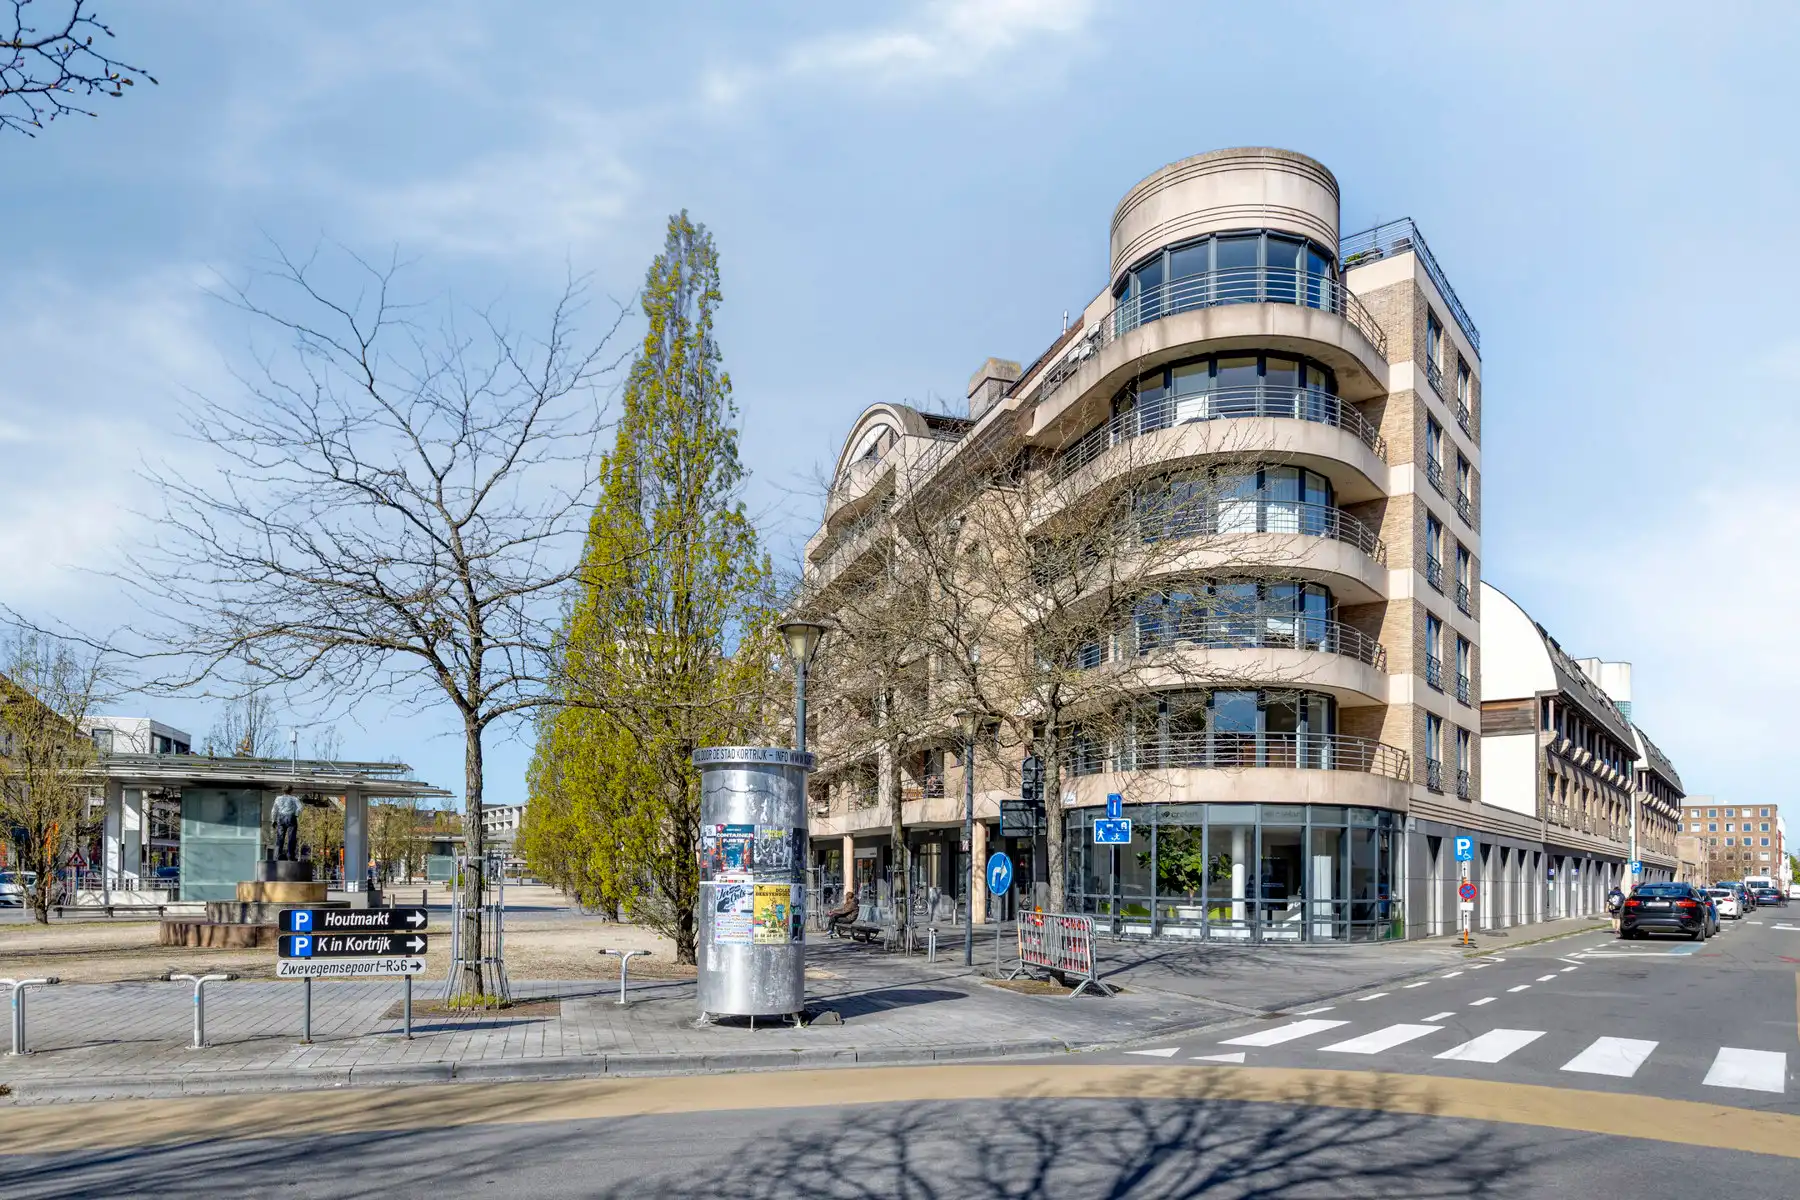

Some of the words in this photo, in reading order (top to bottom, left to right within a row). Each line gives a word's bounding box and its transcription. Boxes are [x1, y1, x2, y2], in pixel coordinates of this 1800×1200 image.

[721, 748, 735, 760] STAD
[737, 748, 767, 761] KORTRIJK
[775, 751, 789, 763] INFO
[1457, 838, 1470, 855] P
[1632, 862, 1640, 871] P
[295, 912, 309, 931] P
[325, 911, 389, 926] Houtmarkt
[295, 937, 309, 956] P
[317, 937, 328, 952] K
[330, 938, 343, 951] in
[345, 936, 392, 954] Kortrijk
